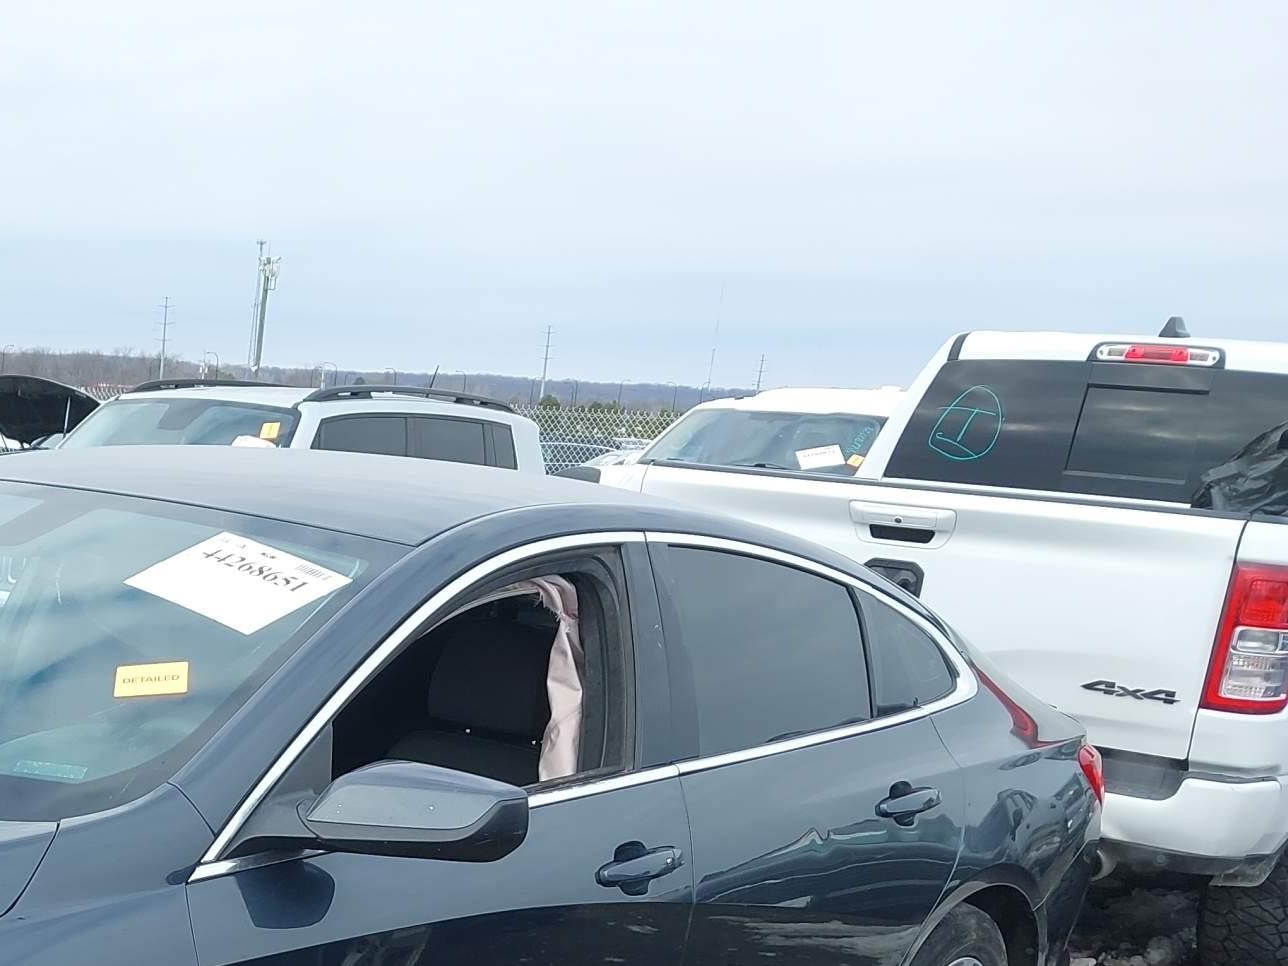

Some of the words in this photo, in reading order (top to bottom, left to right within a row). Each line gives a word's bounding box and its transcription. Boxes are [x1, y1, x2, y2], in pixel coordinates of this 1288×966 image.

[202, 549, 310, 592] 44268651
[122, 674, 181, 685] DETAILED
[1079, 679, 1182, 705] 4x4
